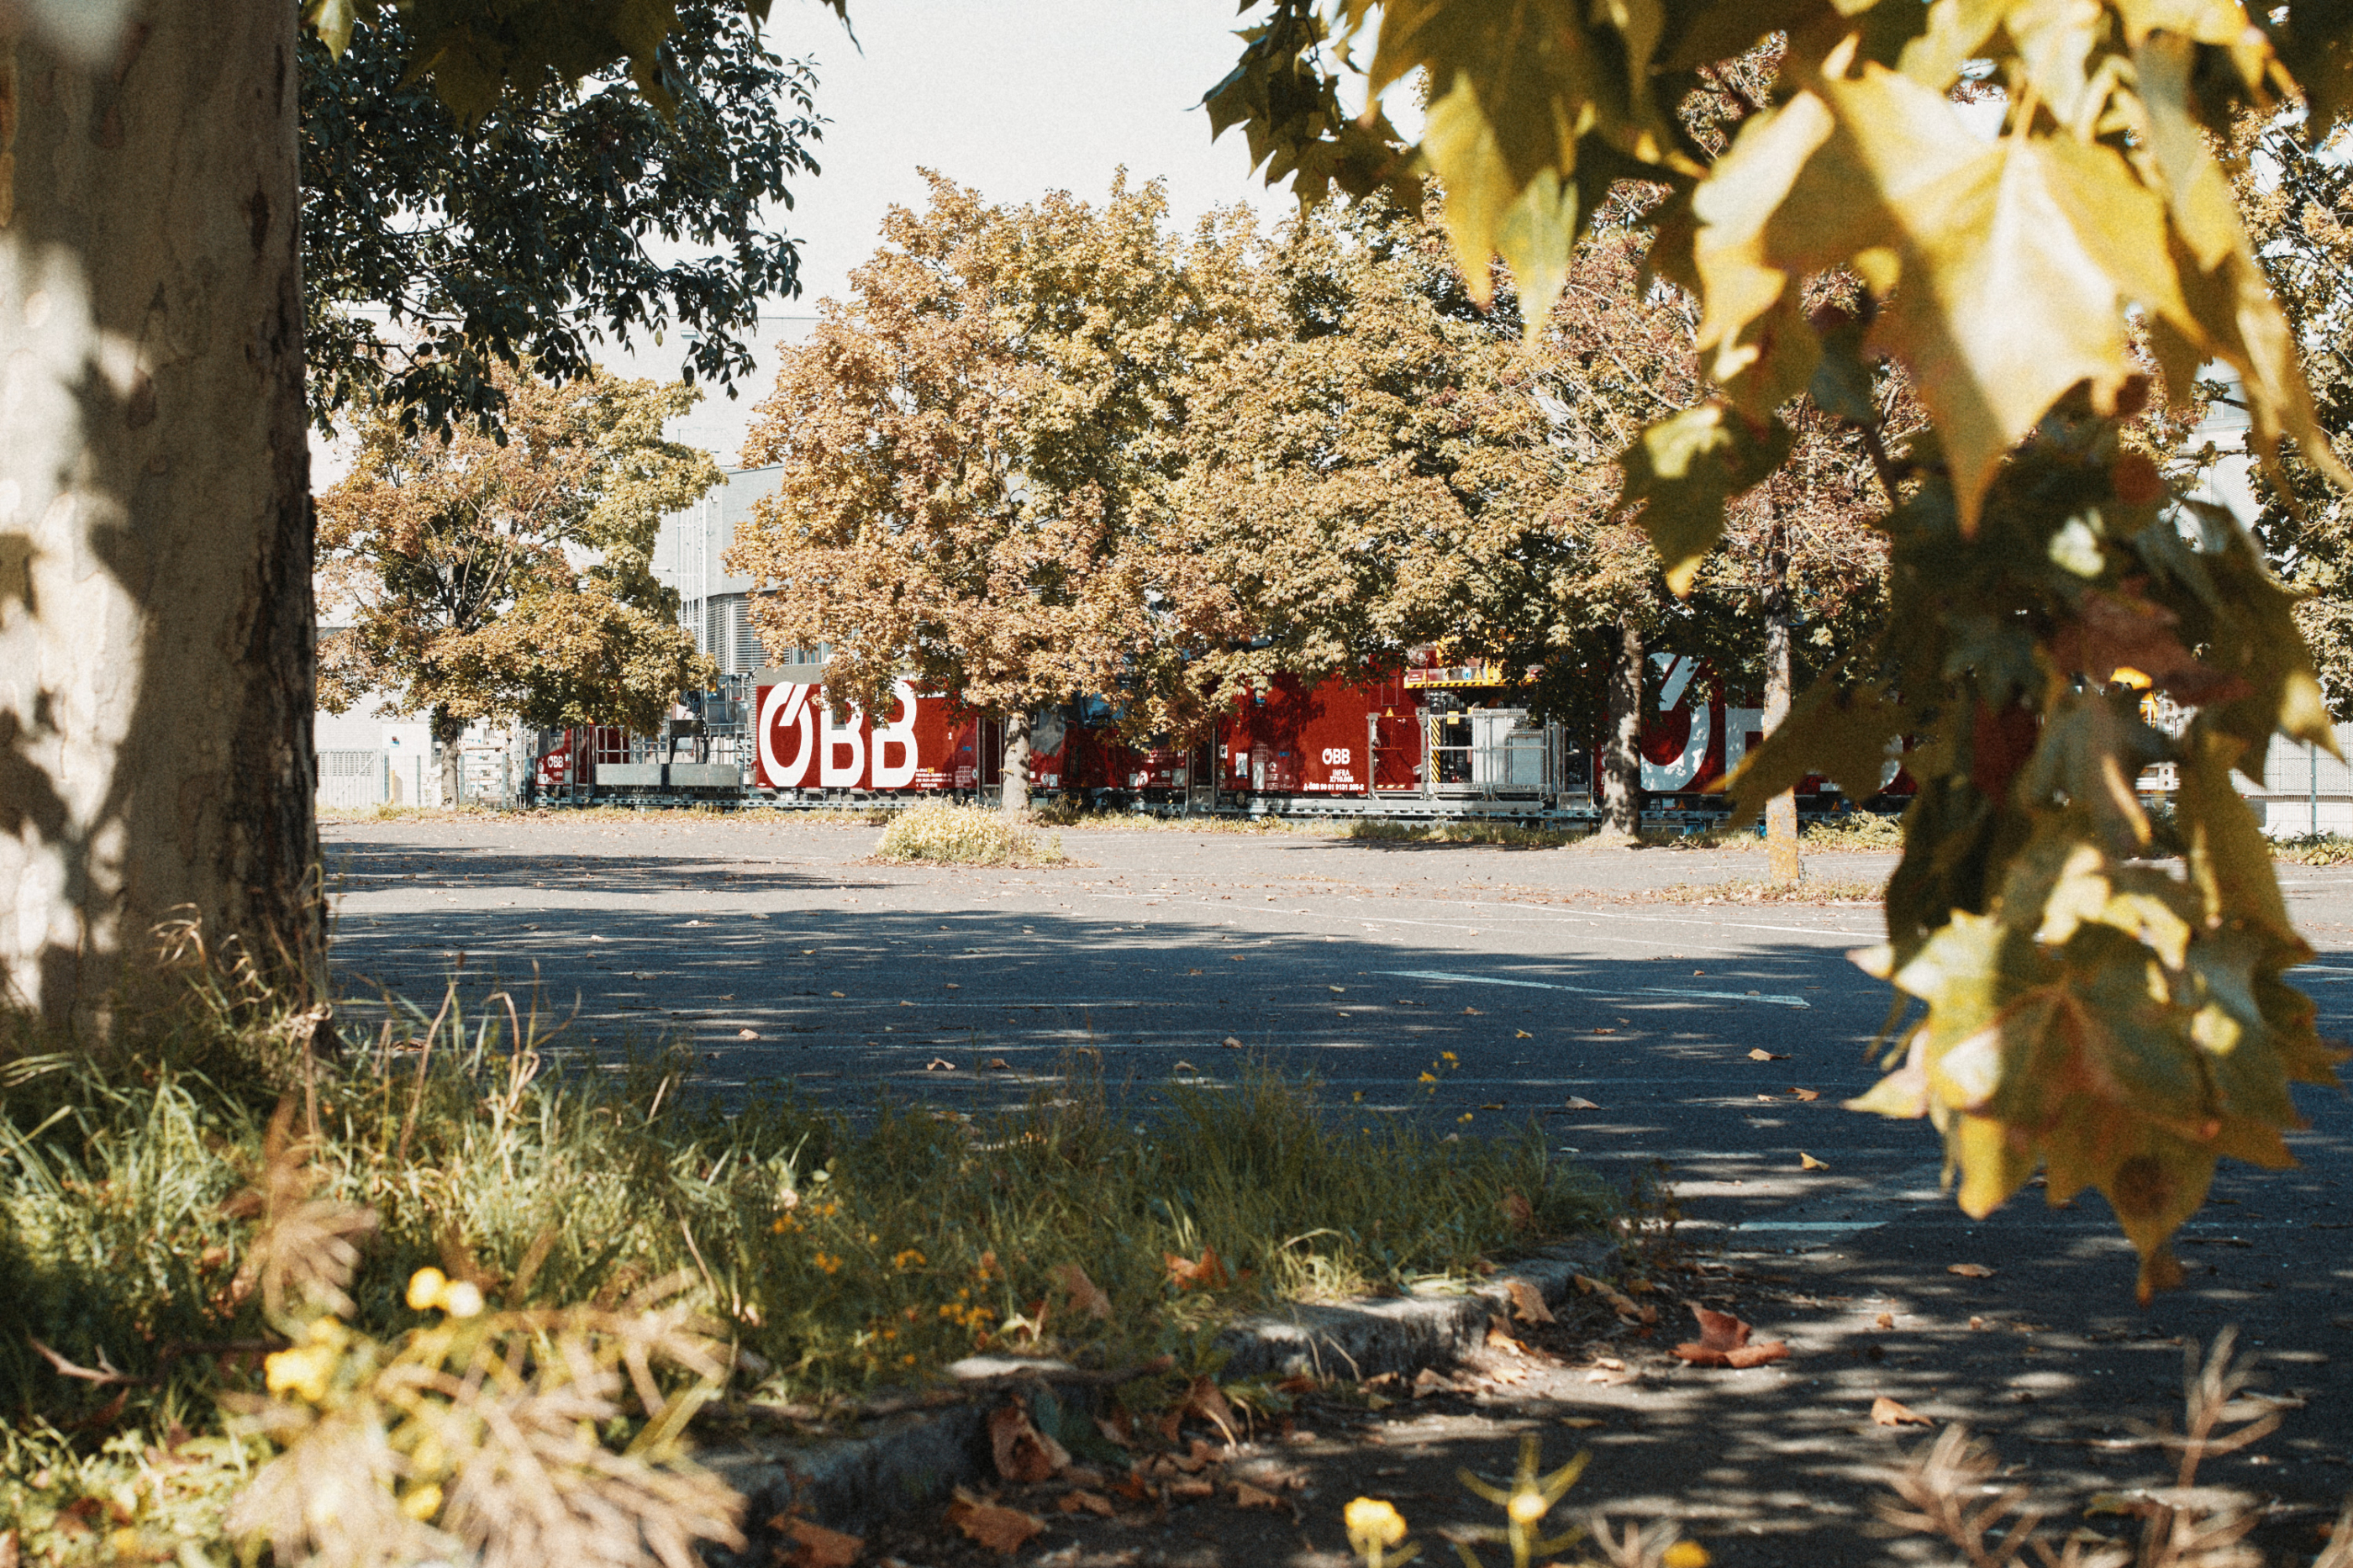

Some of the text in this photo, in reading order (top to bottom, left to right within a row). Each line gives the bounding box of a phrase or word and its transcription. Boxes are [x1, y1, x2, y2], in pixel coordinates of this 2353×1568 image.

[759, 681, 919, 787] ÖBB
[547, 755, 563, 768] ÖBB
[1322, 748, 1350, 765] ÖBB
